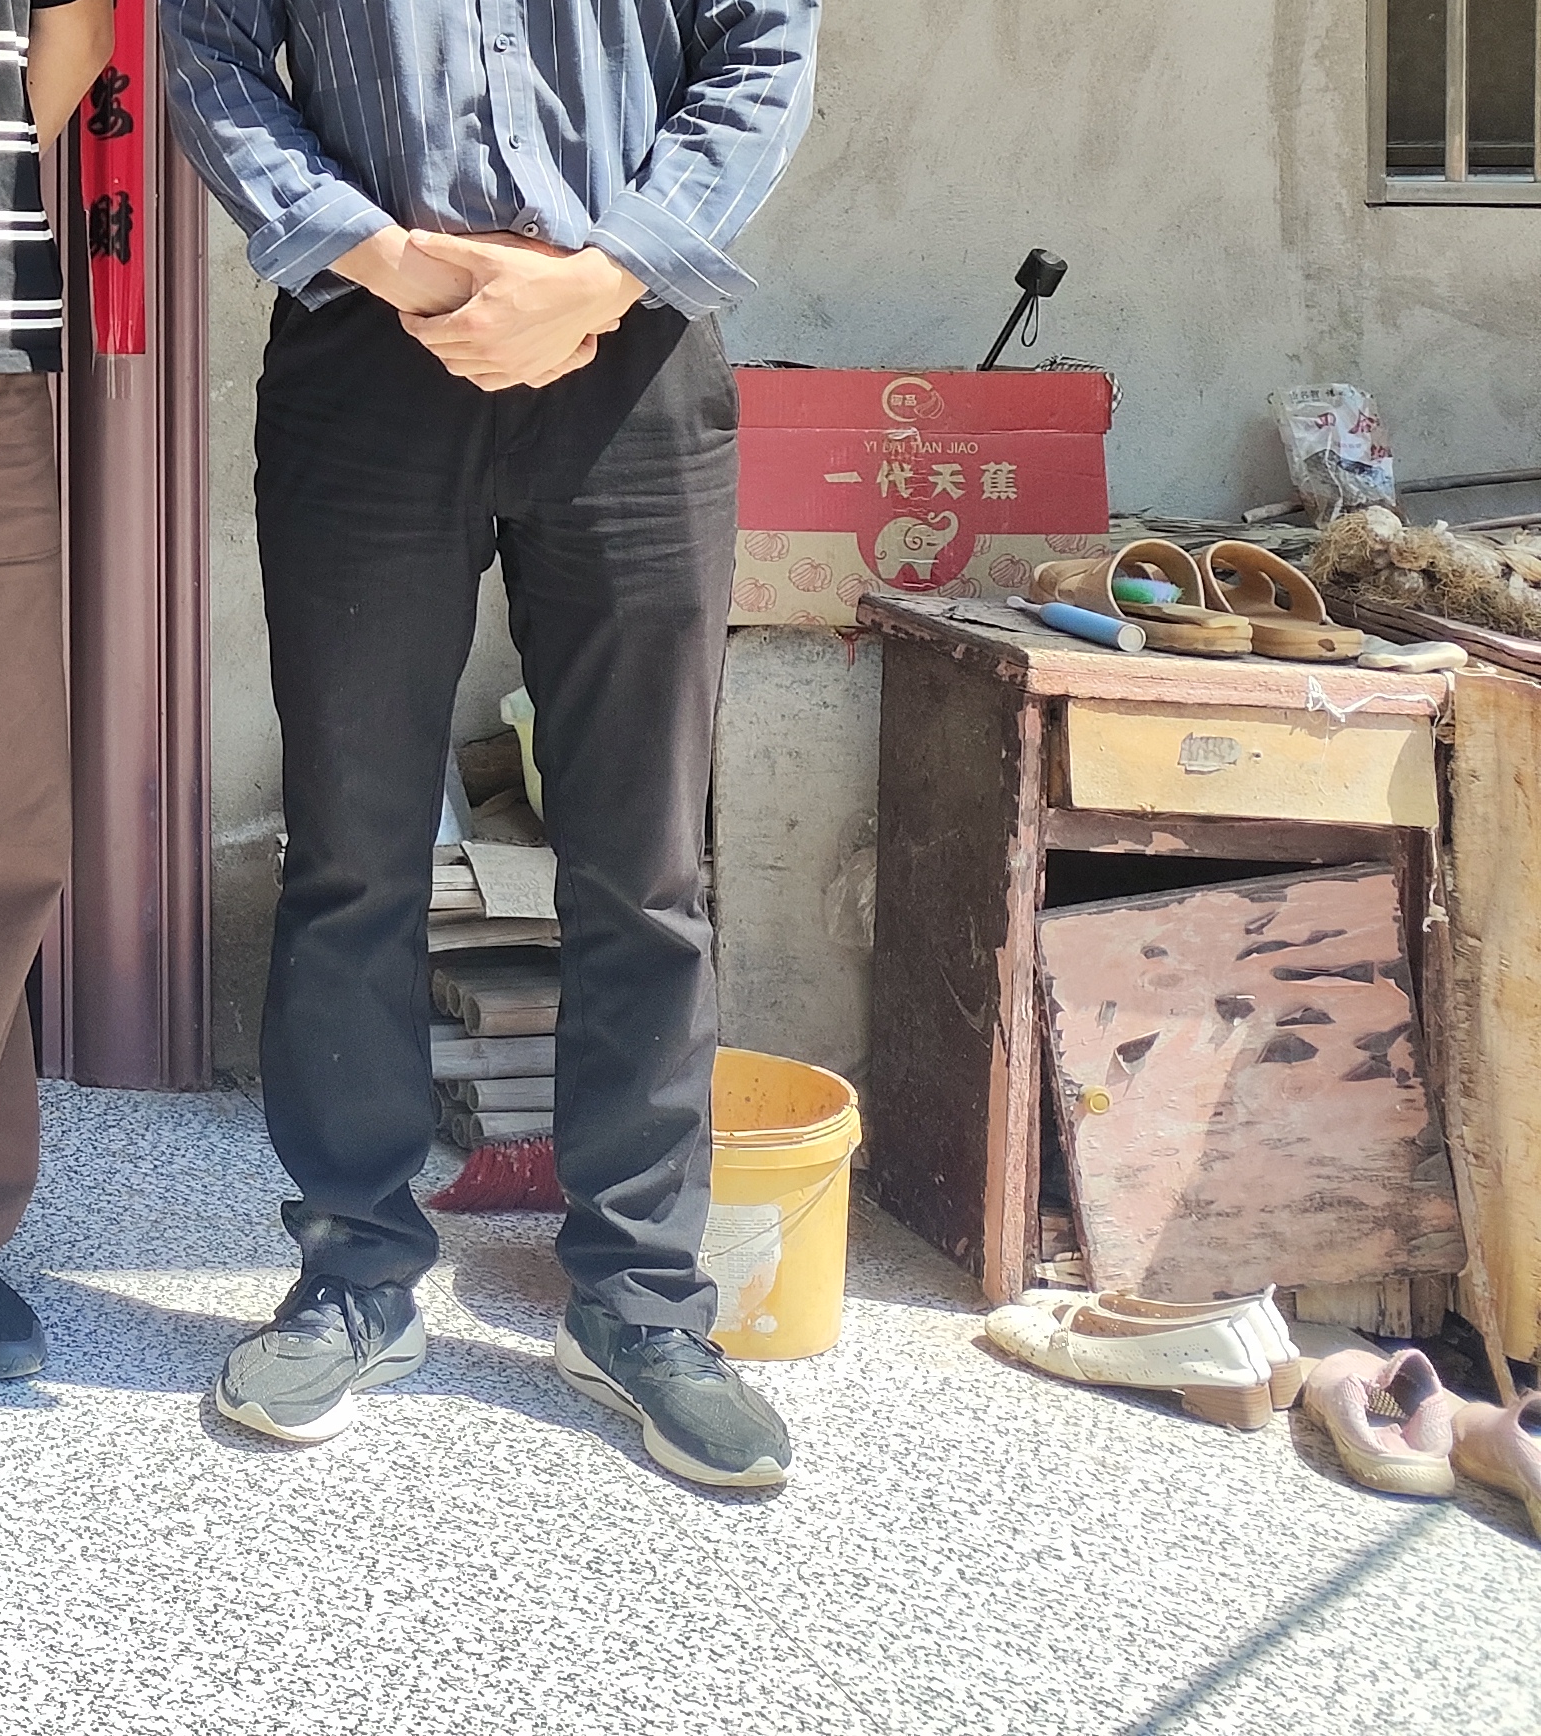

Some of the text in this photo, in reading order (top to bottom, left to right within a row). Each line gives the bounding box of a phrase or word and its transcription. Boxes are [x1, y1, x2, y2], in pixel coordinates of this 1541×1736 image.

[864, 441, 979, 454] YI DAI TIAN JIAO
[823, 460, 1018, 500] 一代天蕉
